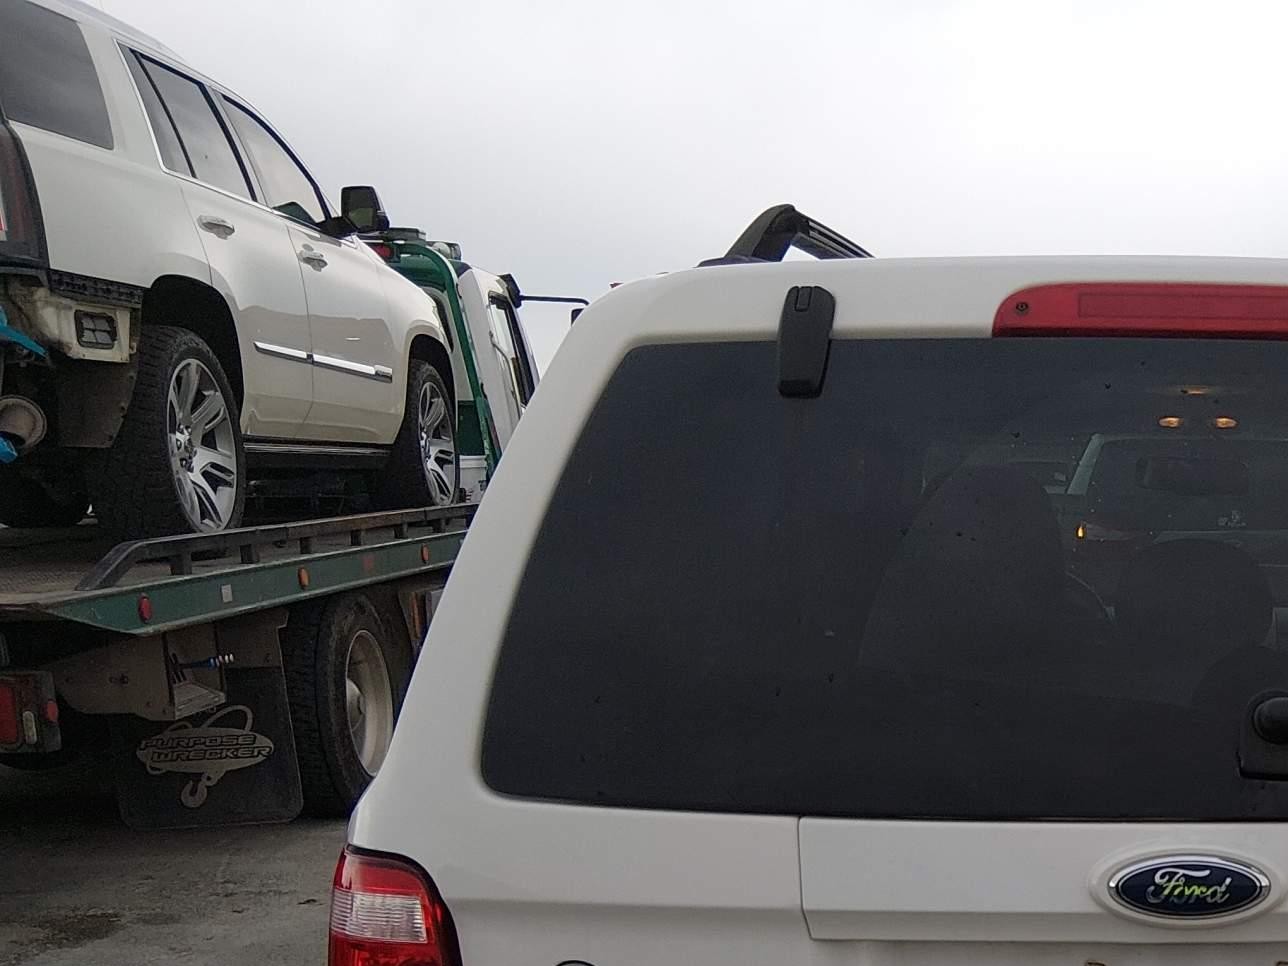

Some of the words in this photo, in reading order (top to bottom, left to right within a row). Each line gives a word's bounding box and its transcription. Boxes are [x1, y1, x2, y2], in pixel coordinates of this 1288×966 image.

[139, 734, 257, 751] PURPOSE
[151, 746, 273, 764] WRECKER
[1146, 866, 1233, 905] Ford
